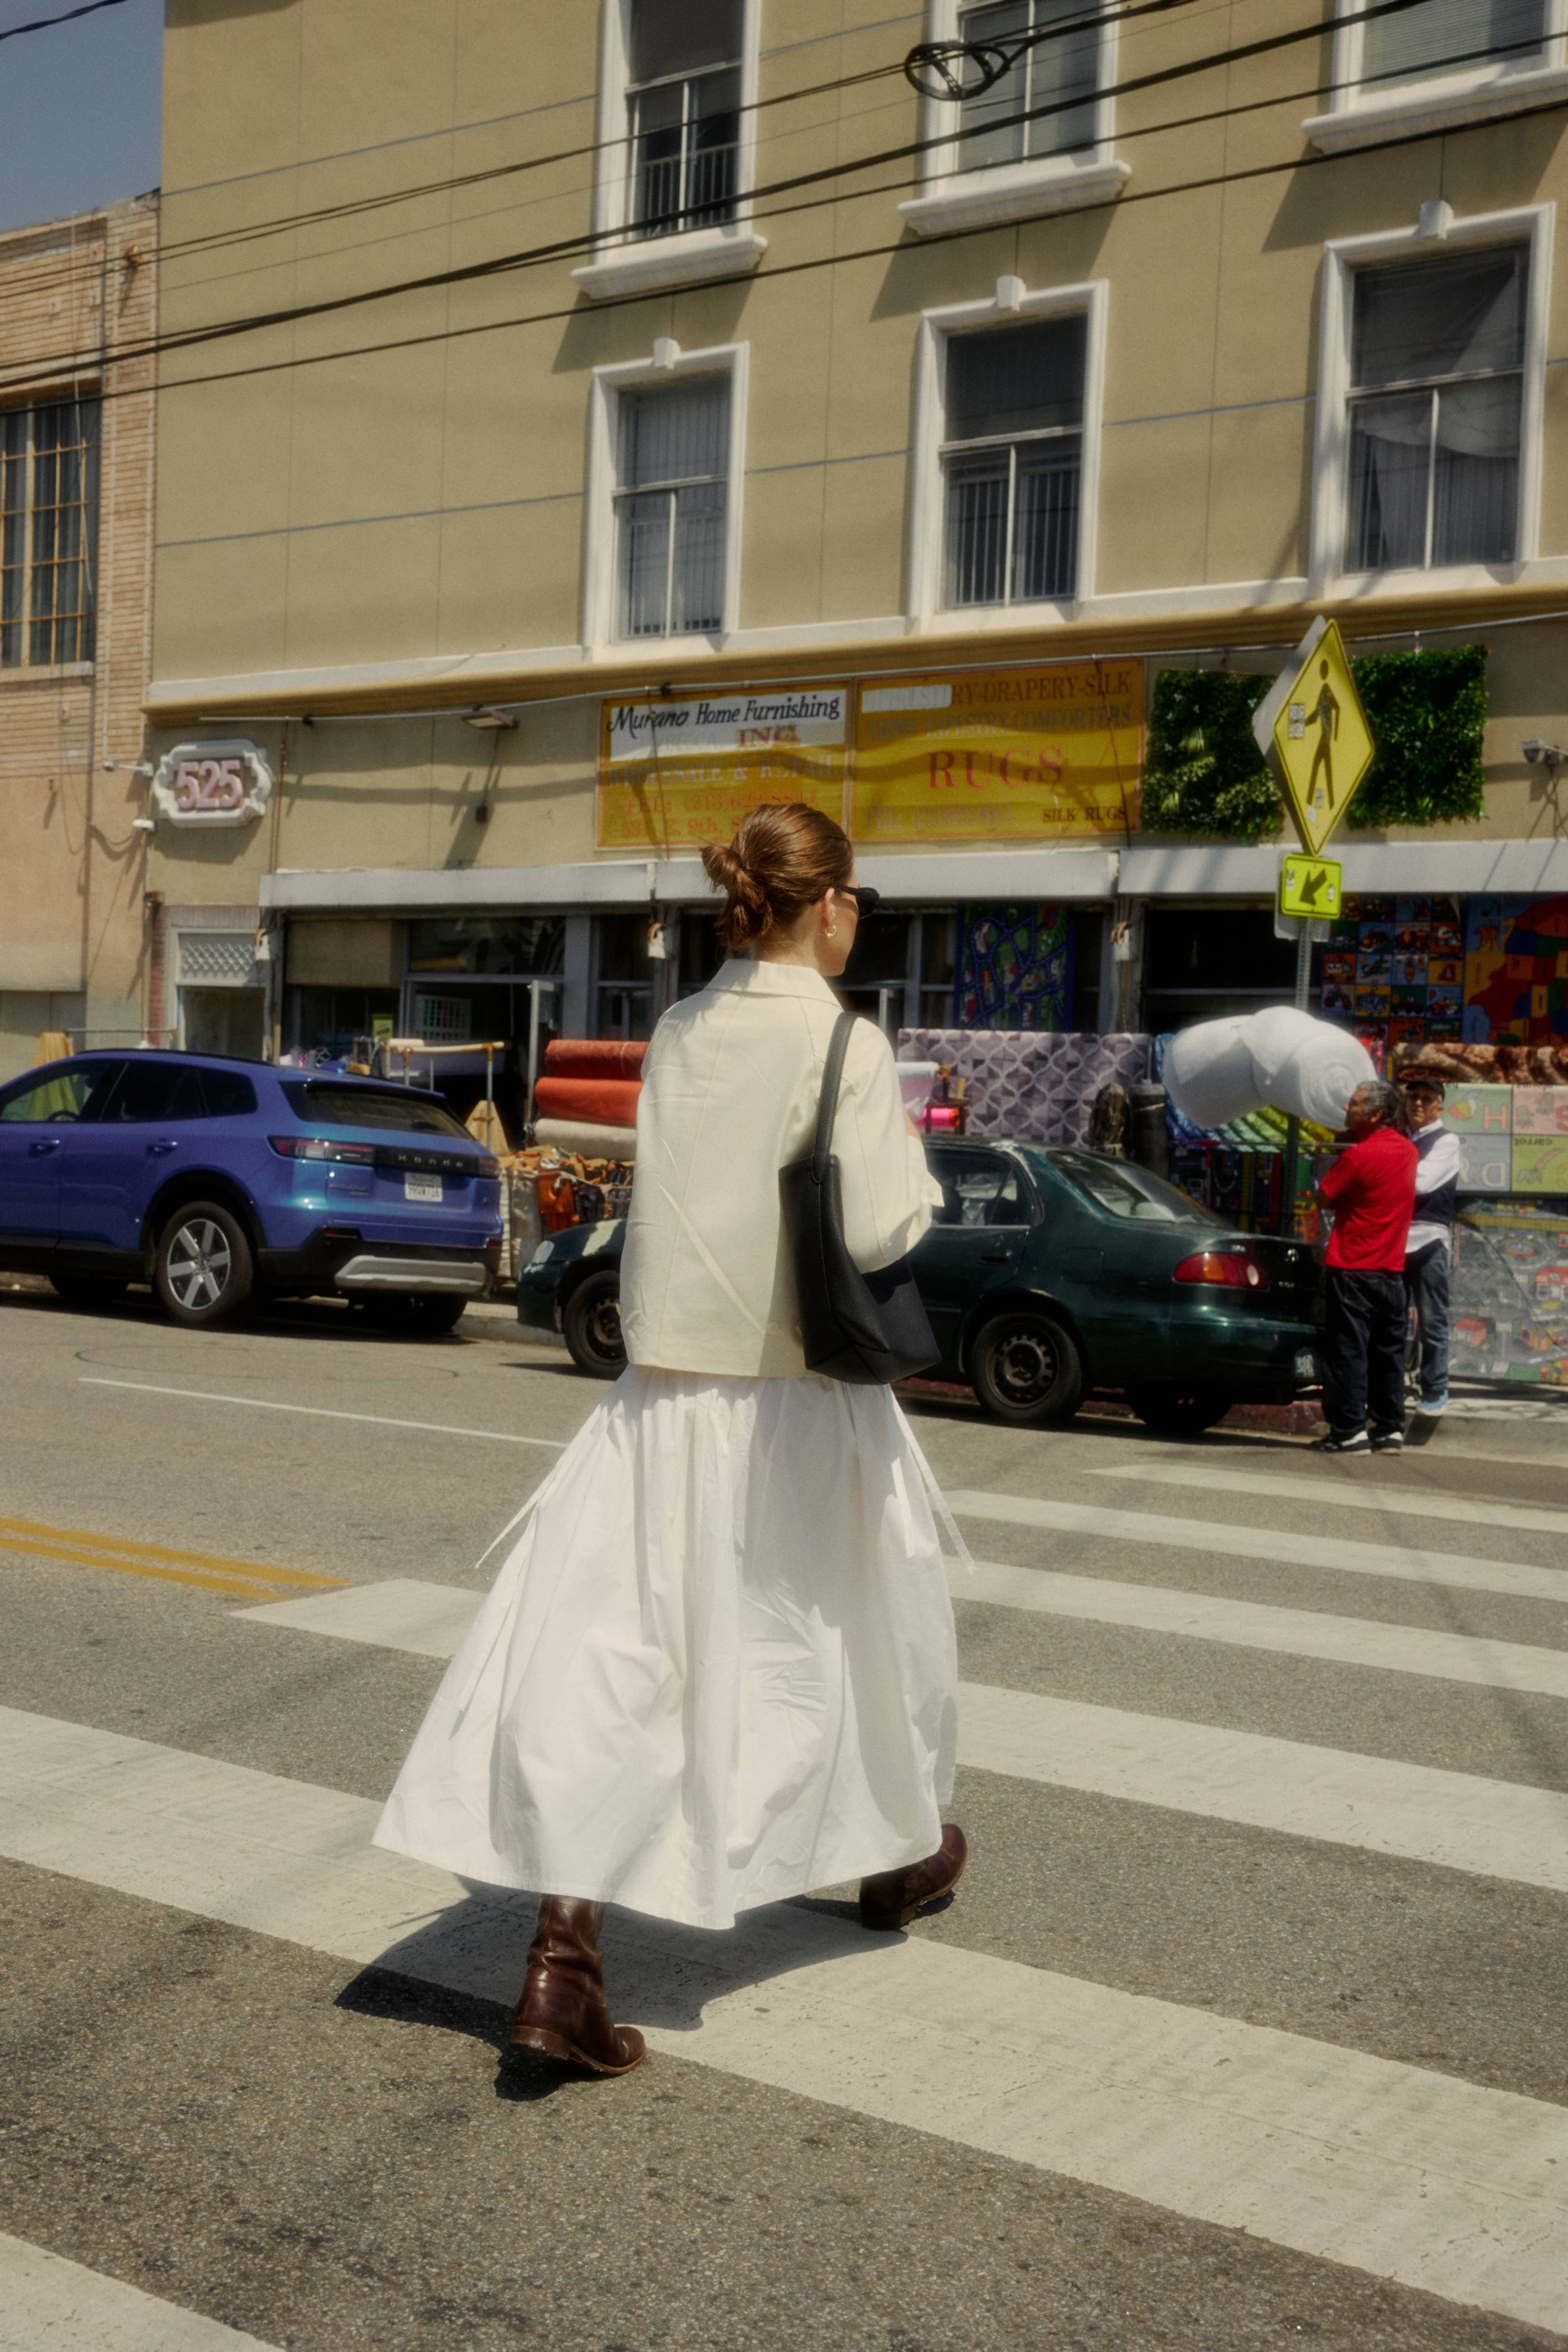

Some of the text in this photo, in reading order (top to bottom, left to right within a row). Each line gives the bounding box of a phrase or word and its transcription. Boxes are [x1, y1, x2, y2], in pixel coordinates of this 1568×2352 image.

[607, 695, 840, 739] Murano Home Furnishing
[176, 759, 243, 809] 525
[609, 755, 839, 787] WHOLESALE & RETAIL
[927, 744, 1063, 789] RUGS
[1043, 806, 1077, 823] SILK
[1085, 805, 1126, 823] RUGS
[1482, 1104, 1508, 1131] H
